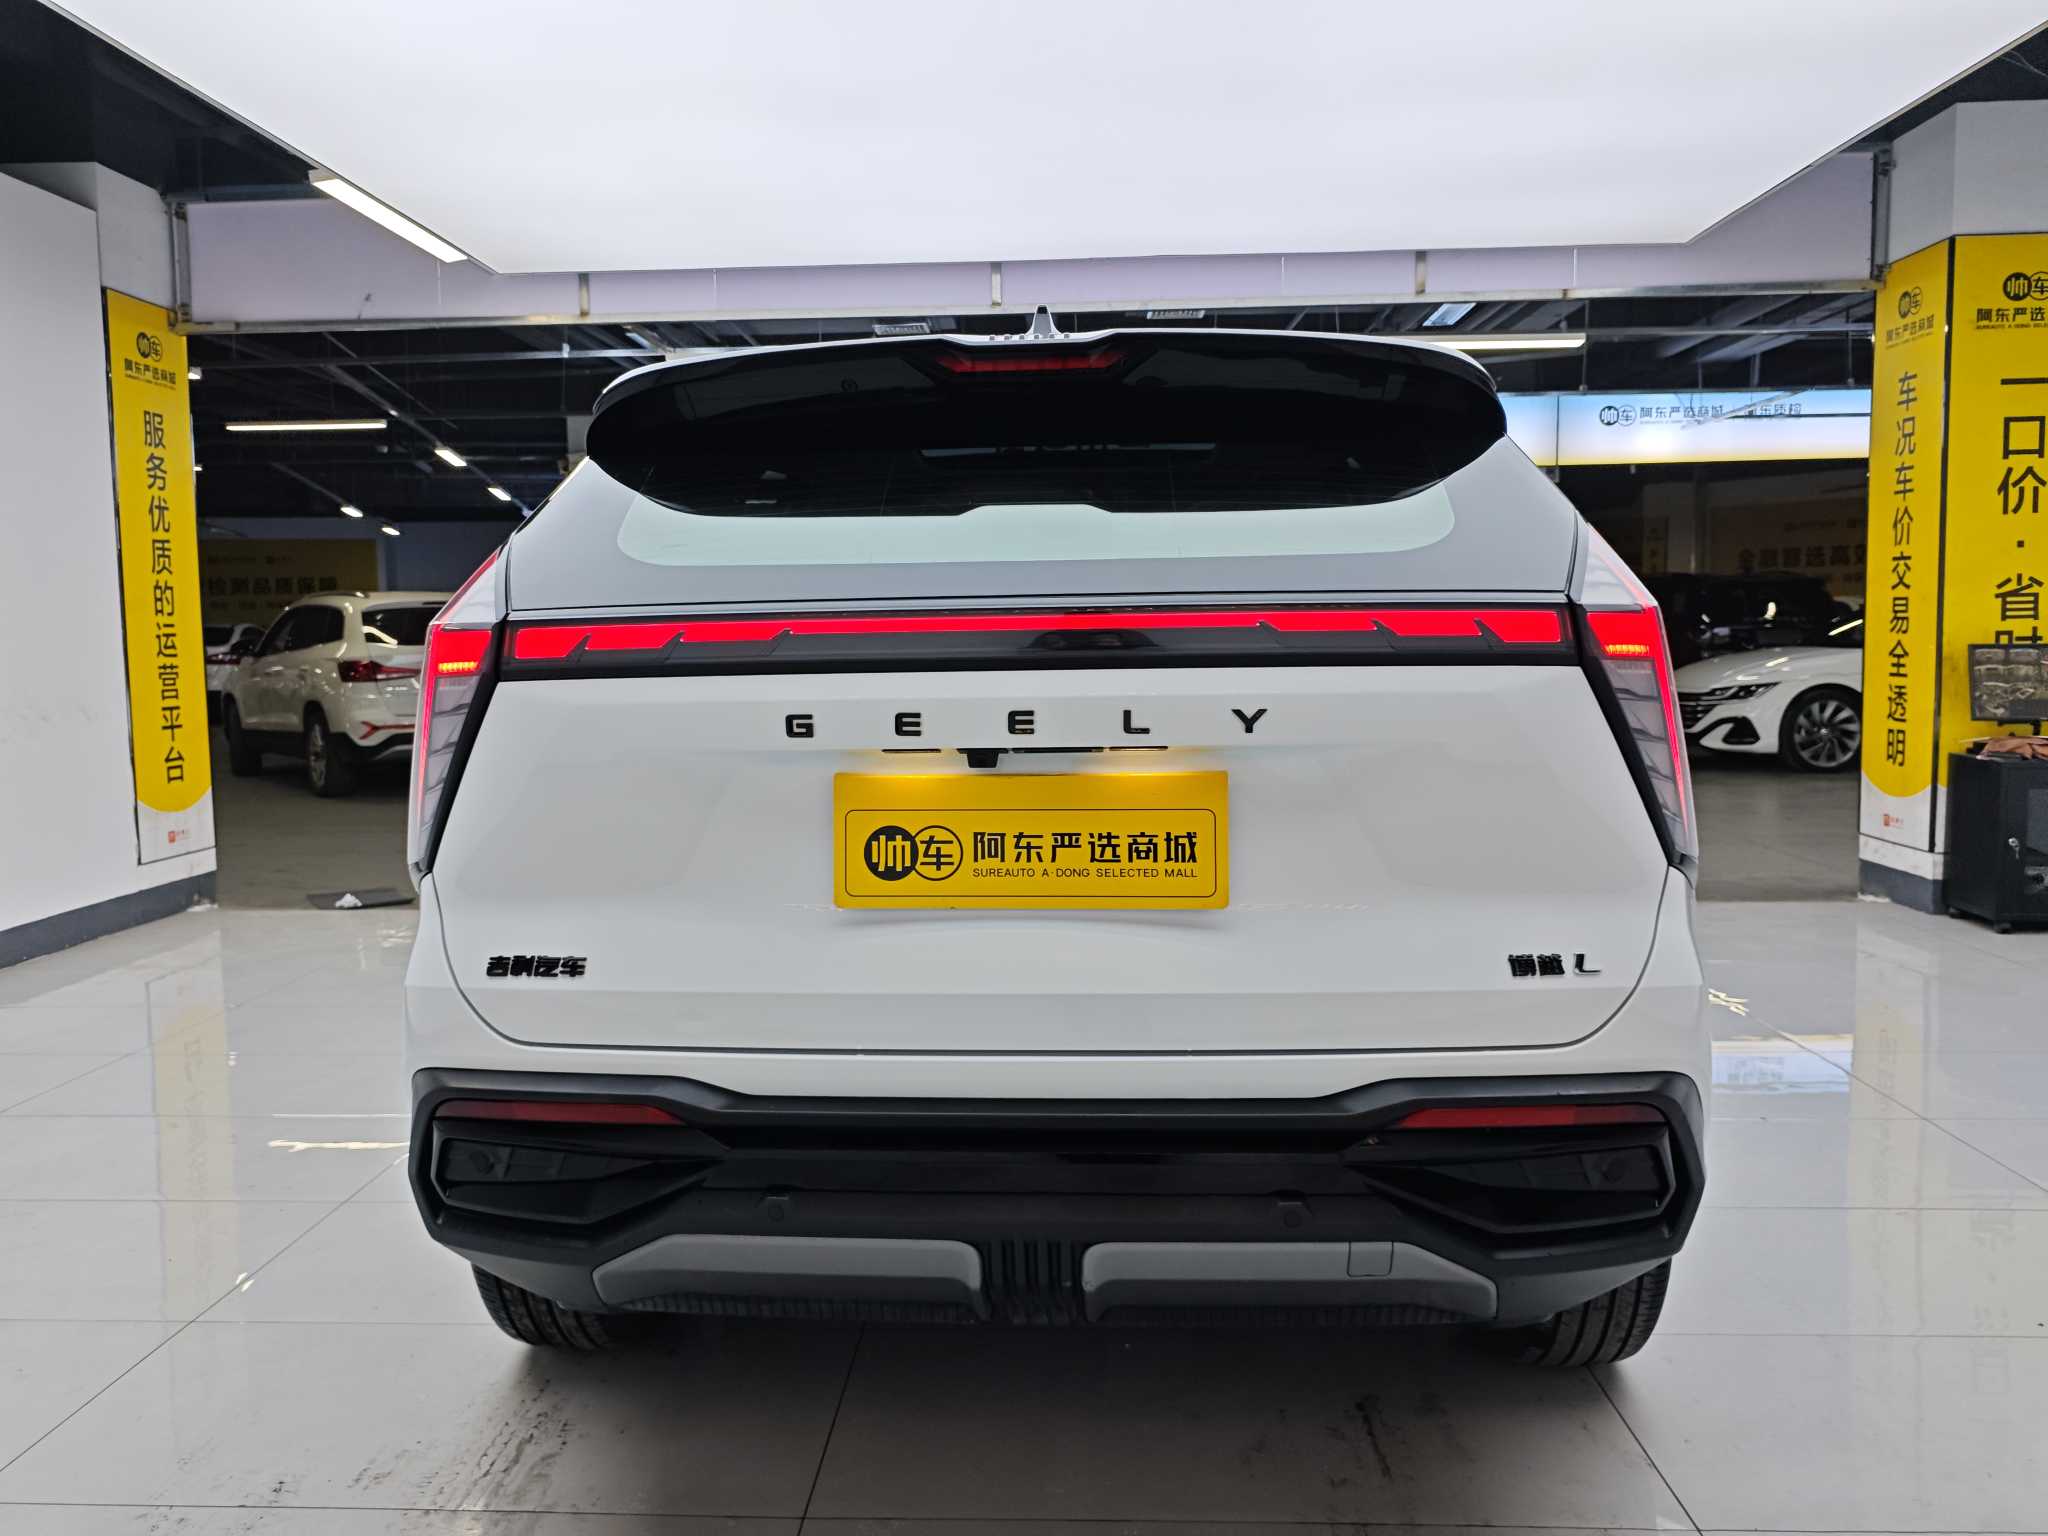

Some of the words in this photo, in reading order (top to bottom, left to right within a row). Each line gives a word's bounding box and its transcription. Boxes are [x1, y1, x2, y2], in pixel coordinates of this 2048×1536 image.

[1886, 371, 1918, 768] 车况车价交易全透明
[143, 410, 184, 784] 服务优质的运营平台
[785, 708, 1268, 739] GEELY
[866, 827, 961, 879] 帅车
[972, 831, 1198, 863] 阿东严选商城
[972, 867, 1036, 879] SUREAUTO
[1095, 867, 1160, 879] SELECTED
[1164, 867, 1198, 879] MALL
